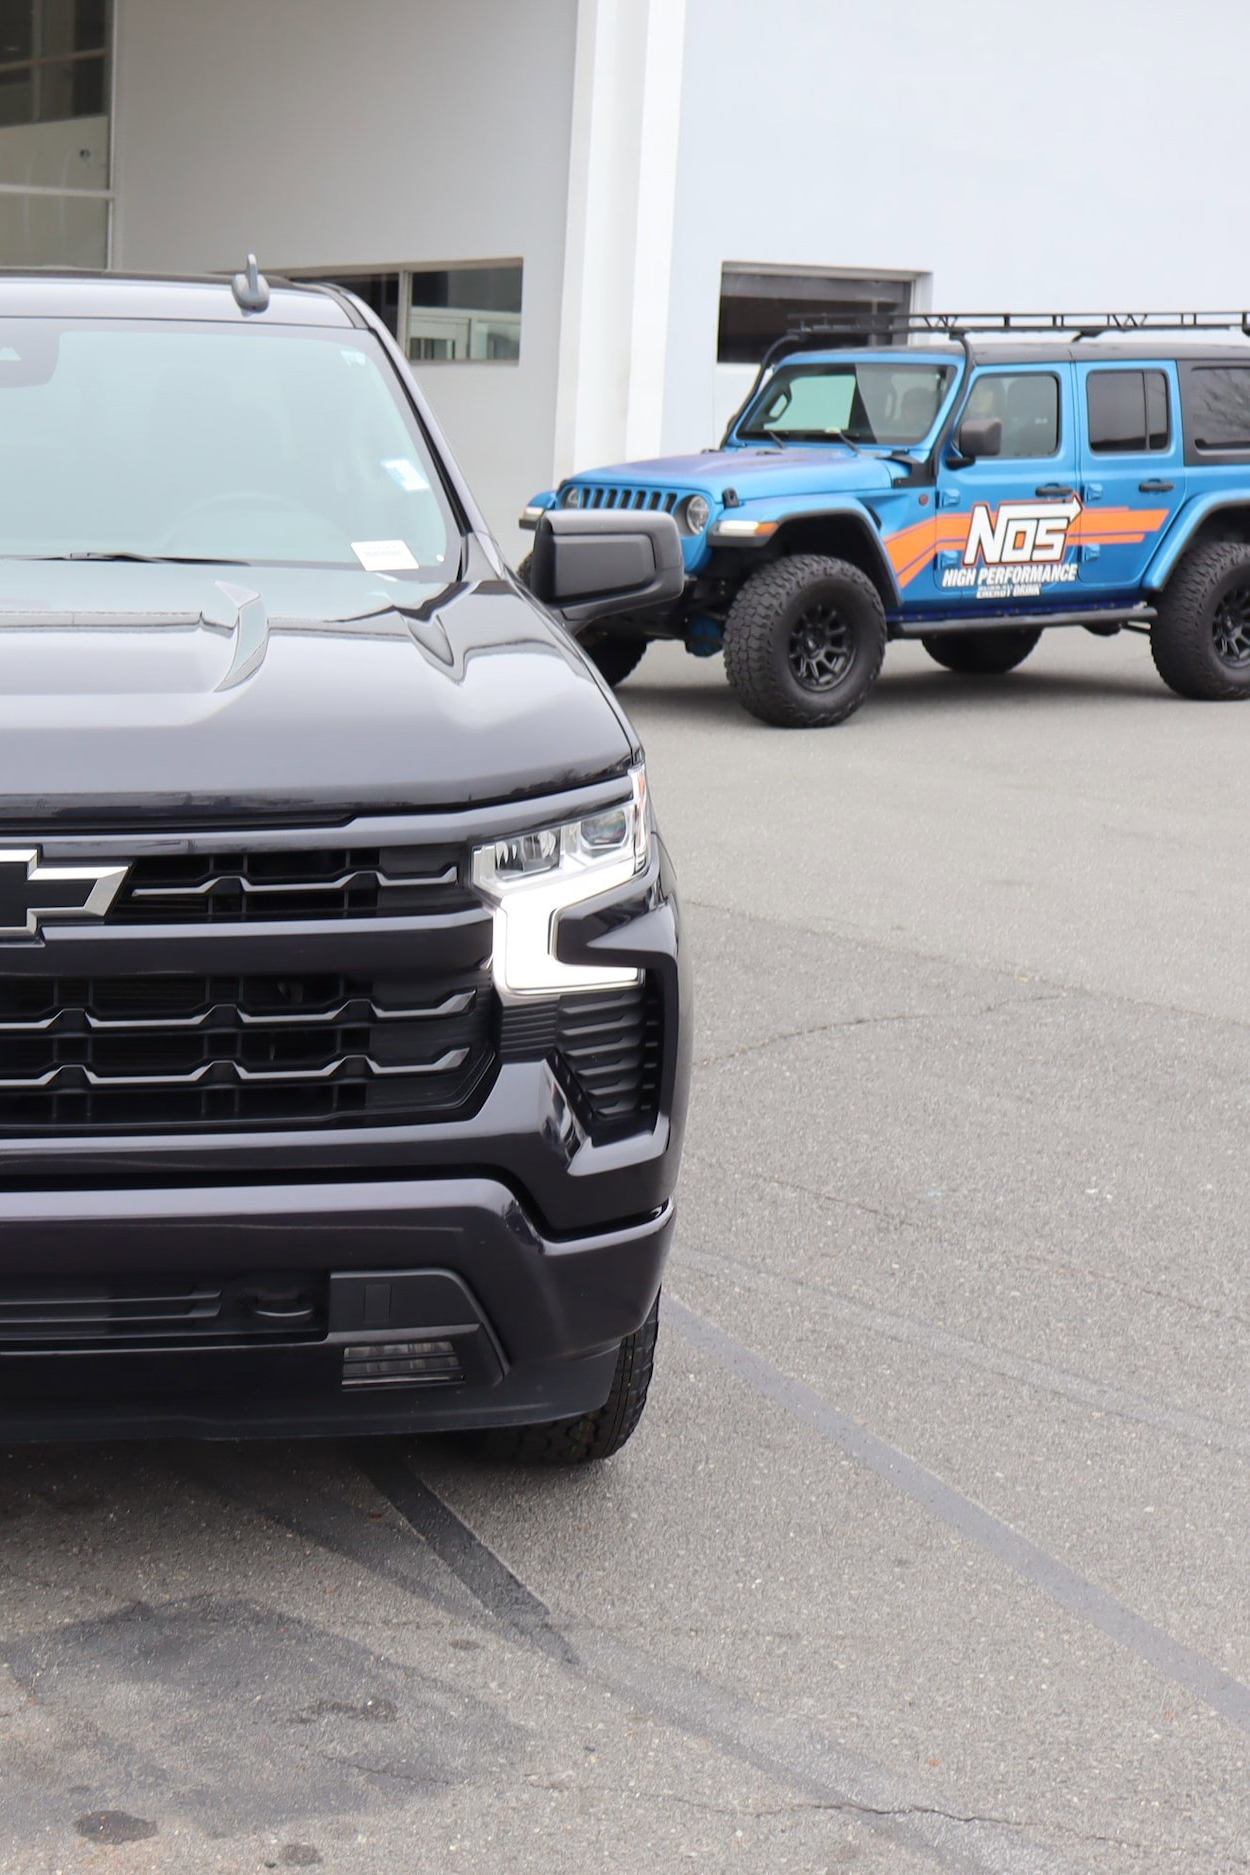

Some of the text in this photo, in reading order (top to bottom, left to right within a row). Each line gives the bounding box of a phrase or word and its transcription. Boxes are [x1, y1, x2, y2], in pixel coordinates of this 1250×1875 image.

[961, 493, 1083, 566] NOS
[942, 564, 1078, 586] HIGH PERFORMANCE
[1013, 583, 1042, 597] DRINK
